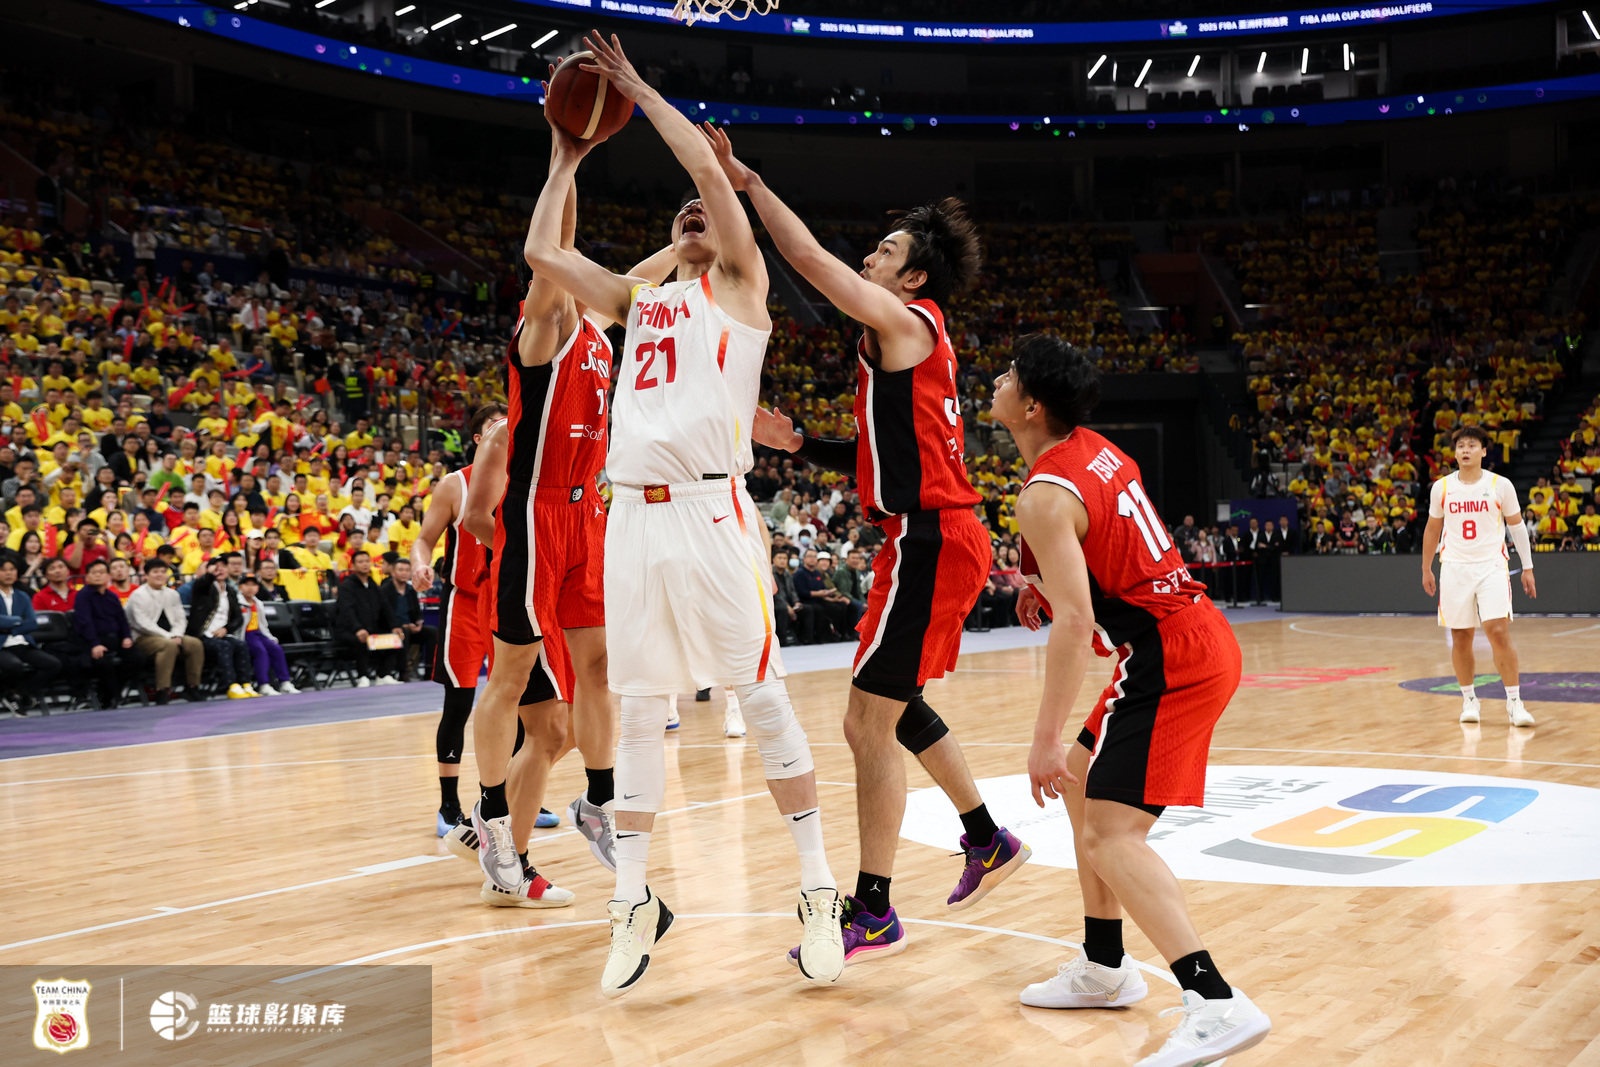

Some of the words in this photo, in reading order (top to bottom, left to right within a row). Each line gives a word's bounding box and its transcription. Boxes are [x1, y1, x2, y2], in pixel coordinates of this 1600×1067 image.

[1300, 14, 1320, 24] FIBA
[1321, 12, 1341, 23] ASIA
[1341, 10, 1360, 21] CUP
[1381, 2, 1433, 17] QUALIFIERS
[838, 24, 857, 33] FIBA
[914, 27, 932, 37] FIBA
[933, 28, 951, 37] ASIA
[951, 29, 968, 38] CUP
[987, 29, 1033, 38] QUALIFIERS
[1218, 21, 1238, 31] FIBA
[635, 337, 677, 391] 21
[1449, 500, 1489, 514] CHINA
[1117, 478, 1172, 563] 11
[1462, 519, 1477, 541] 8
